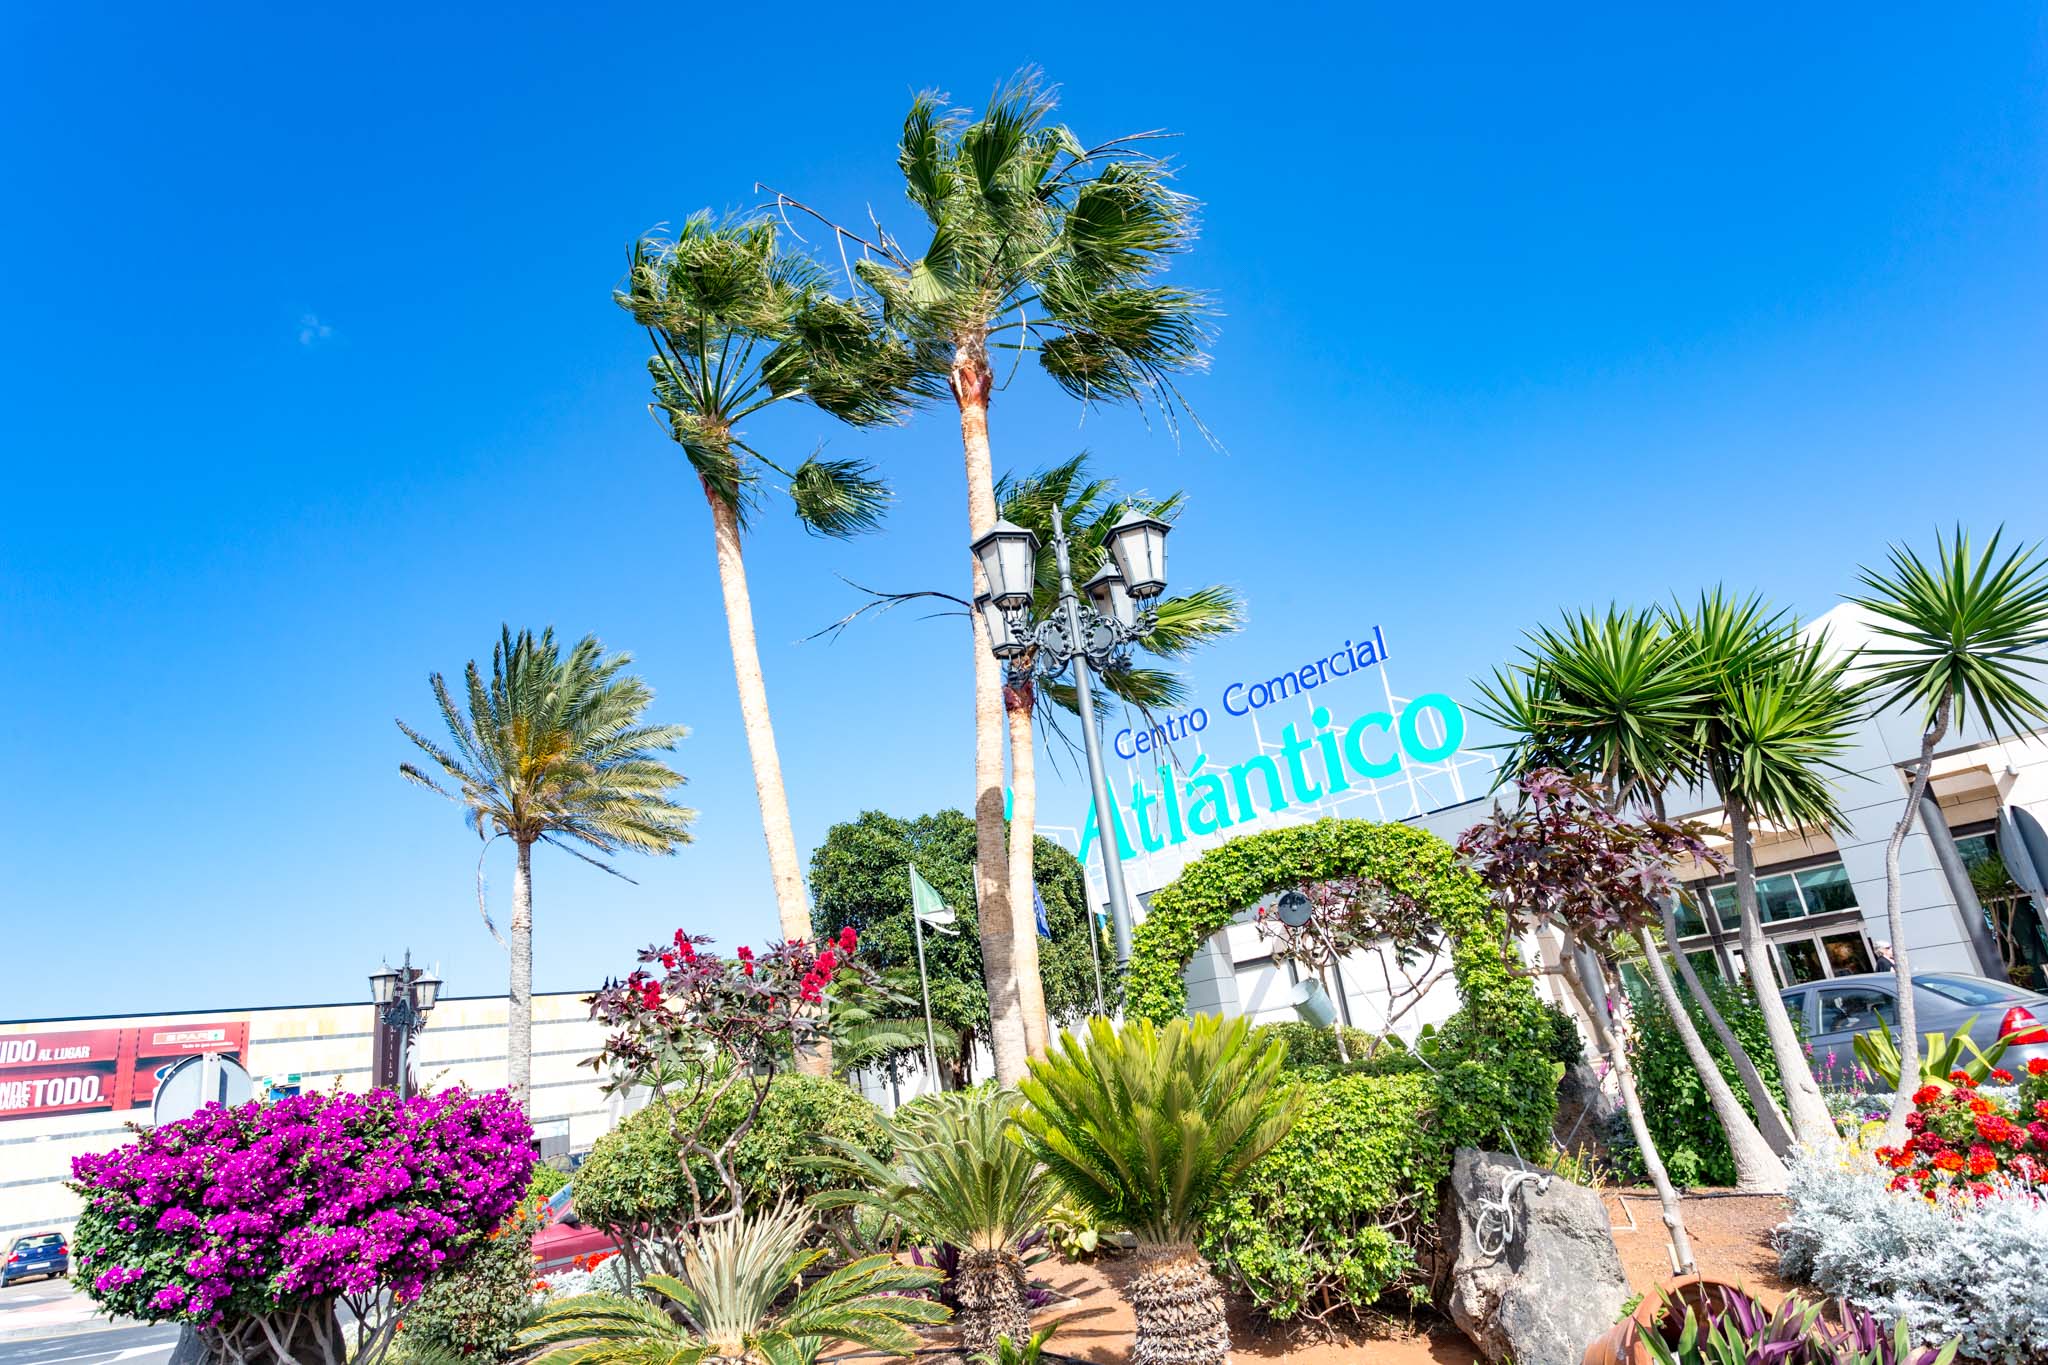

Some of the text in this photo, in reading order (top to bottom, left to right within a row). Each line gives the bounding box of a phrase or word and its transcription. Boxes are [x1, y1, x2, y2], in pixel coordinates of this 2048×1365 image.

[1114, 625, 1389, 760] Centro Comercial
[1077, 692, 1465, 865] Atlántico
[166, 1031, 208, 1042] SPAR
[37, 1045, 91, 1061] AL LUGAR
[32, 1075, 105, 1107] TODO.
